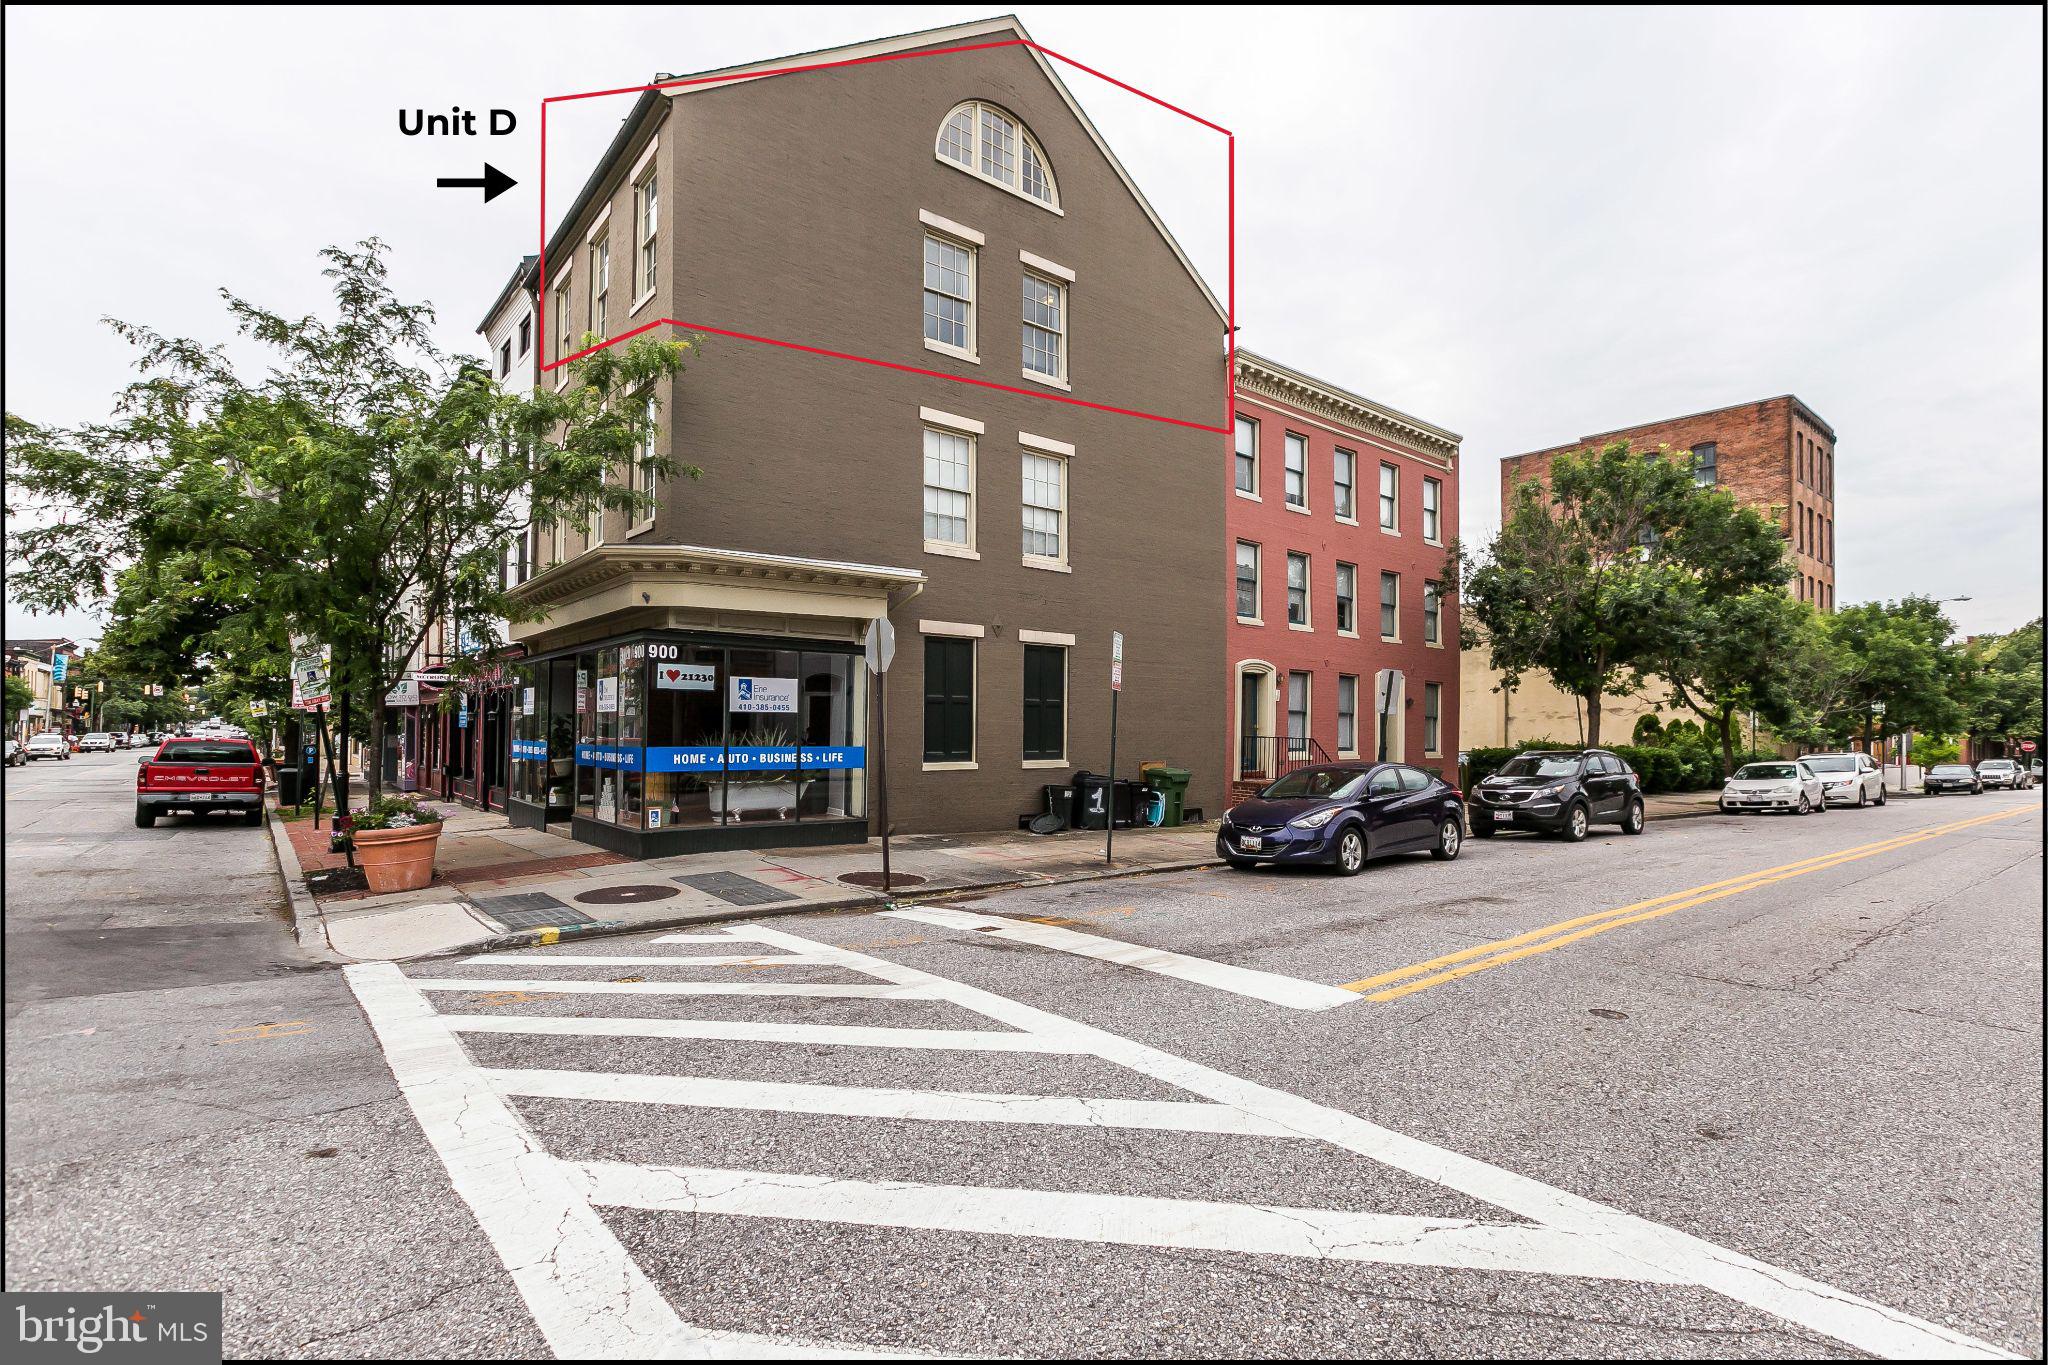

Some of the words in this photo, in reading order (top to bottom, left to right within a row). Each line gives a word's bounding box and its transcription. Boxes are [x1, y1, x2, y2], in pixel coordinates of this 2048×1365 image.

[648, 644, 678, 659] 900
[658, 670, 665, 680] I
[680, 673, 714, 683] 21230
[753, 684, 768, 693] Erie
[753, 693, 789, 702] Insurance
[738, 703, 790, 711] 410-385-0455
[673, 753, 706, 765] HOME
[717, 753, 749, 764] AUTO
[759, 753, 813, 763] BUSINESS
[822, 752, 844, 763] LIFE
[1089, 787, 1105, 814] 1
